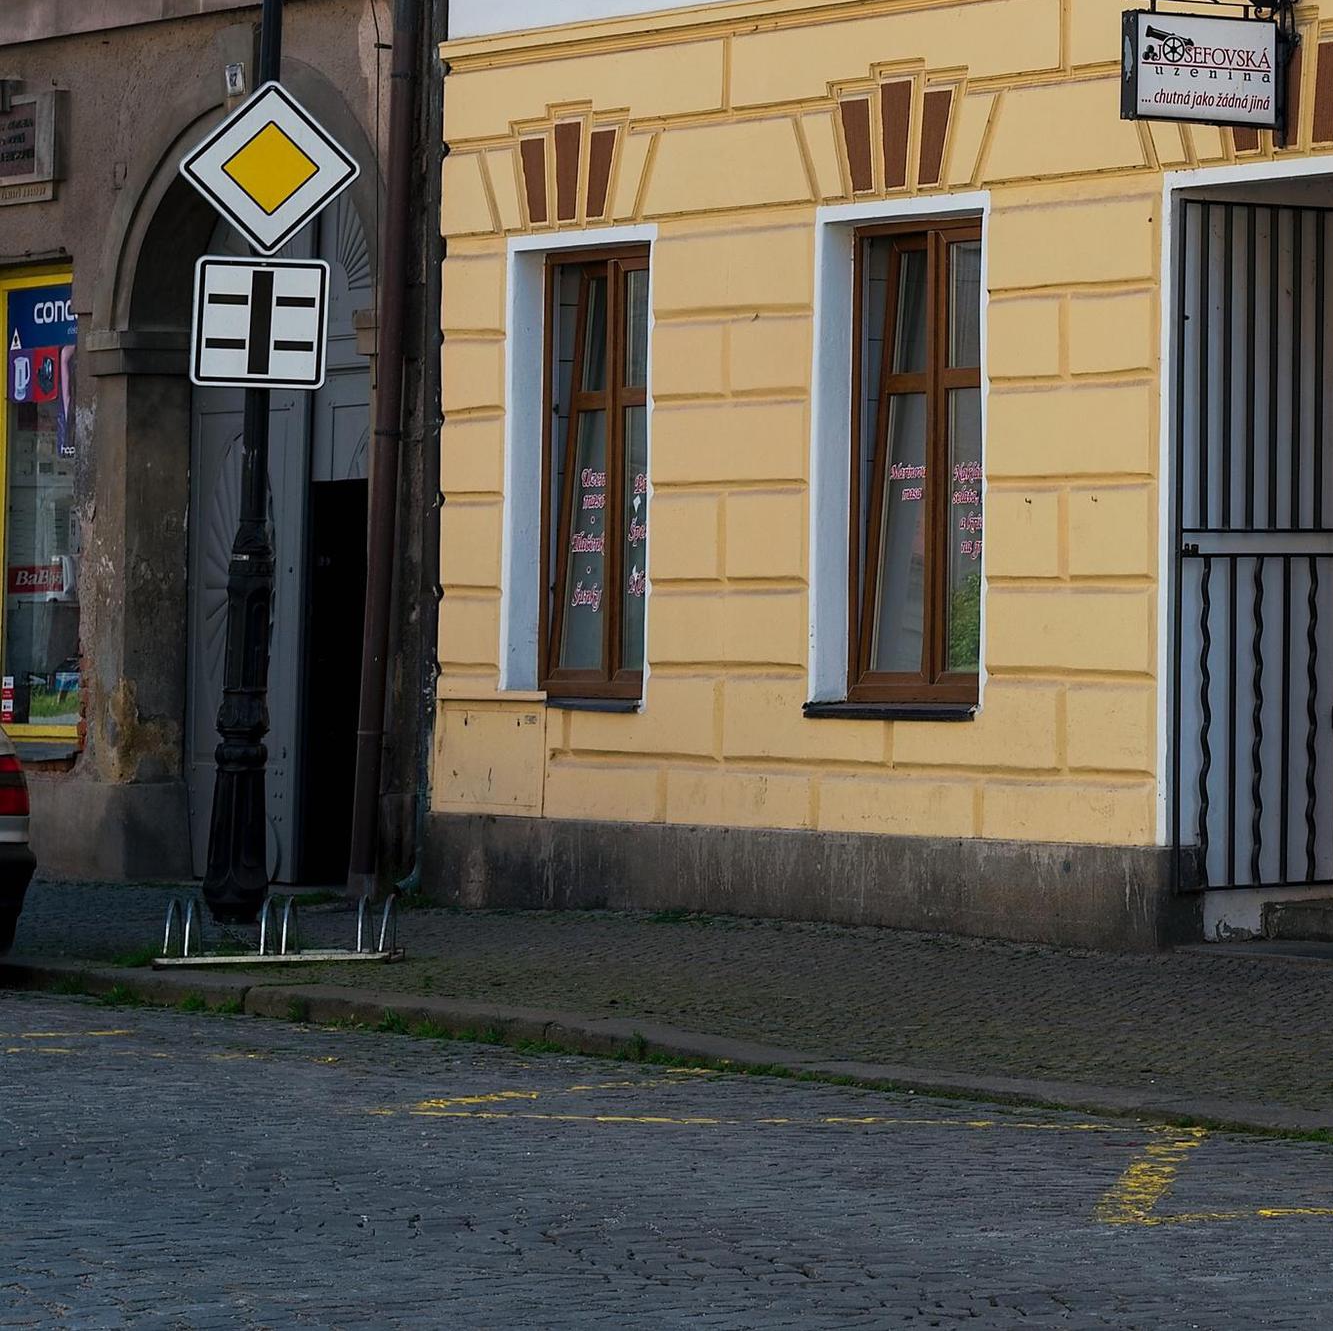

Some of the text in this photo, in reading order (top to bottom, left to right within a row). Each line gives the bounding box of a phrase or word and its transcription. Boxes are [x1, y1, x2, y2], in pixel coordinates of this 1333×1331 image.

[1156, 36, 1272, 69] JOSEFOVSKÁ
[1155, 66, 1271, 83] uzenina
[1154, 88, 1190, 105] chutná
[1190, 91, 1215, 109] jako
[1216, 92, 1249, 109] žádná
[1248, 95, 1271, 113] jiná
[34, 300, 79, 324] conc
